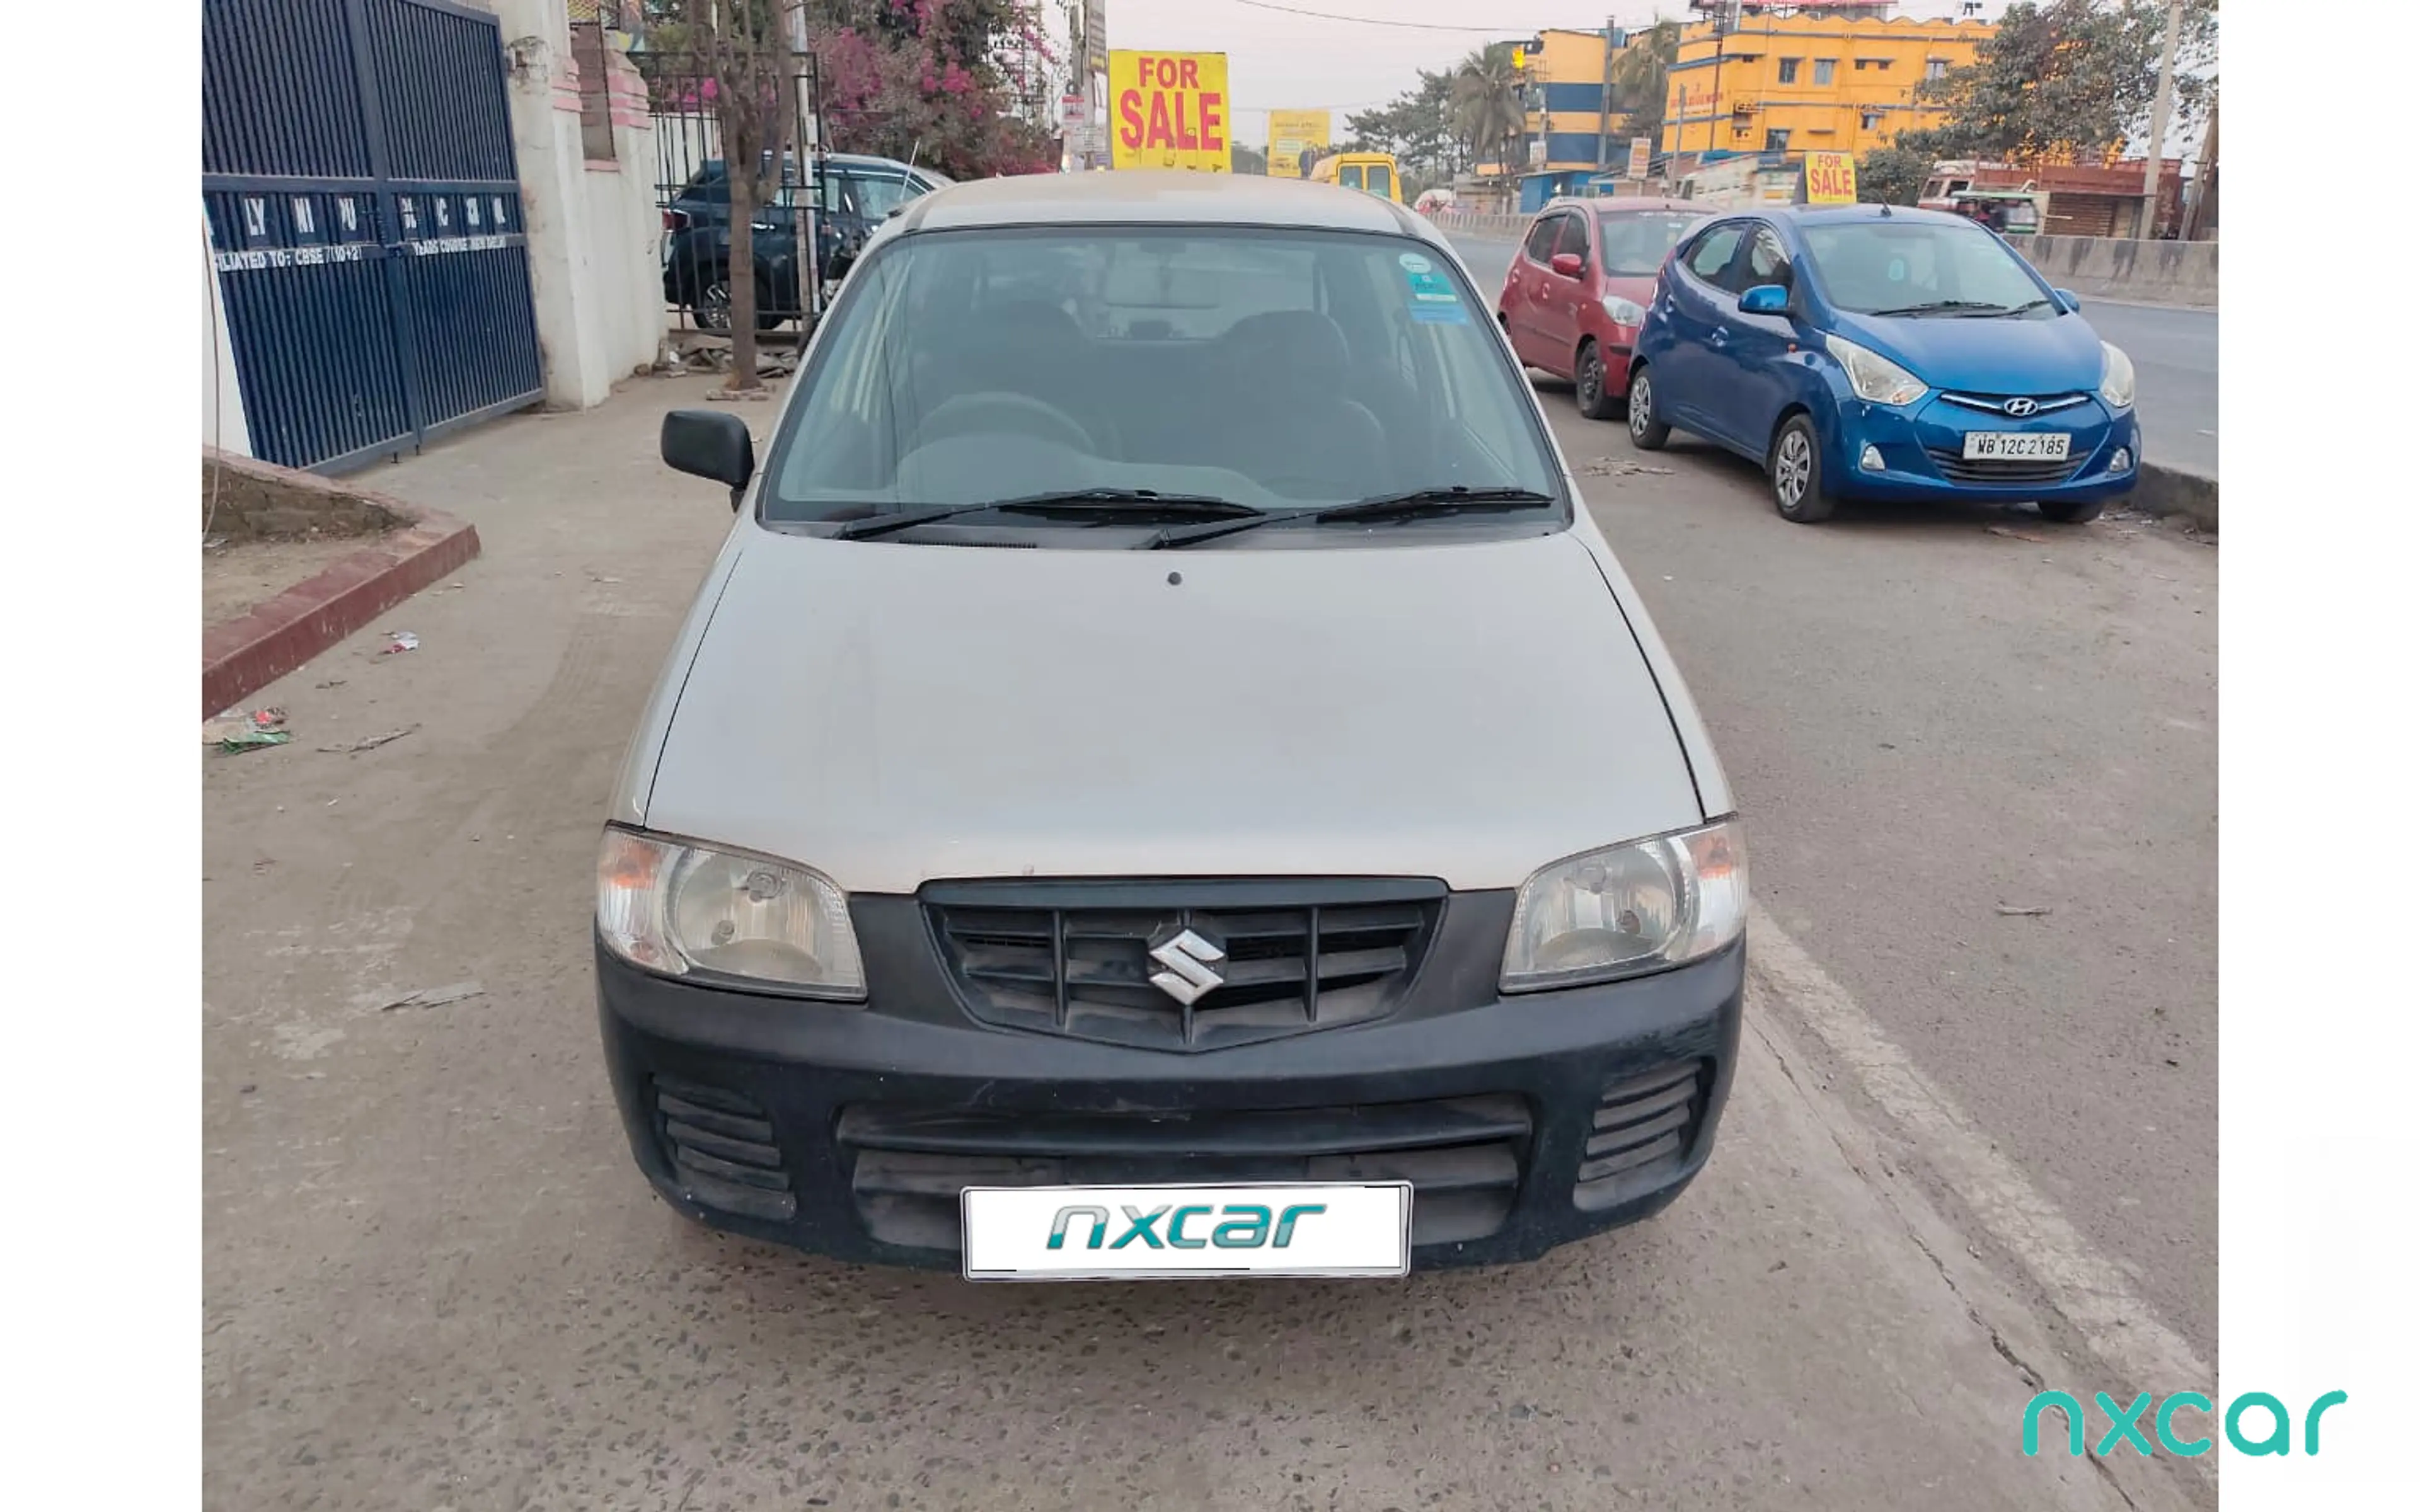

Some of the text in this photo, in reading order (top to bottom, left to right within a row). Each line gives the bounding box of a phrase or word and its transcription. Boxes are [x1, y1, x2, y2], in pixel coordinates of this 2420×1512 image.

[1138, 57, 1200, 89] FOR
[1120, 89, 1223, 151] SALE
[1818, 155, 1843, 168] FOR
[1810, 168, 1853, 196] SALE
[294, 248, 325, 265] CBSE
[1978, 438, 1995, 454] WB
